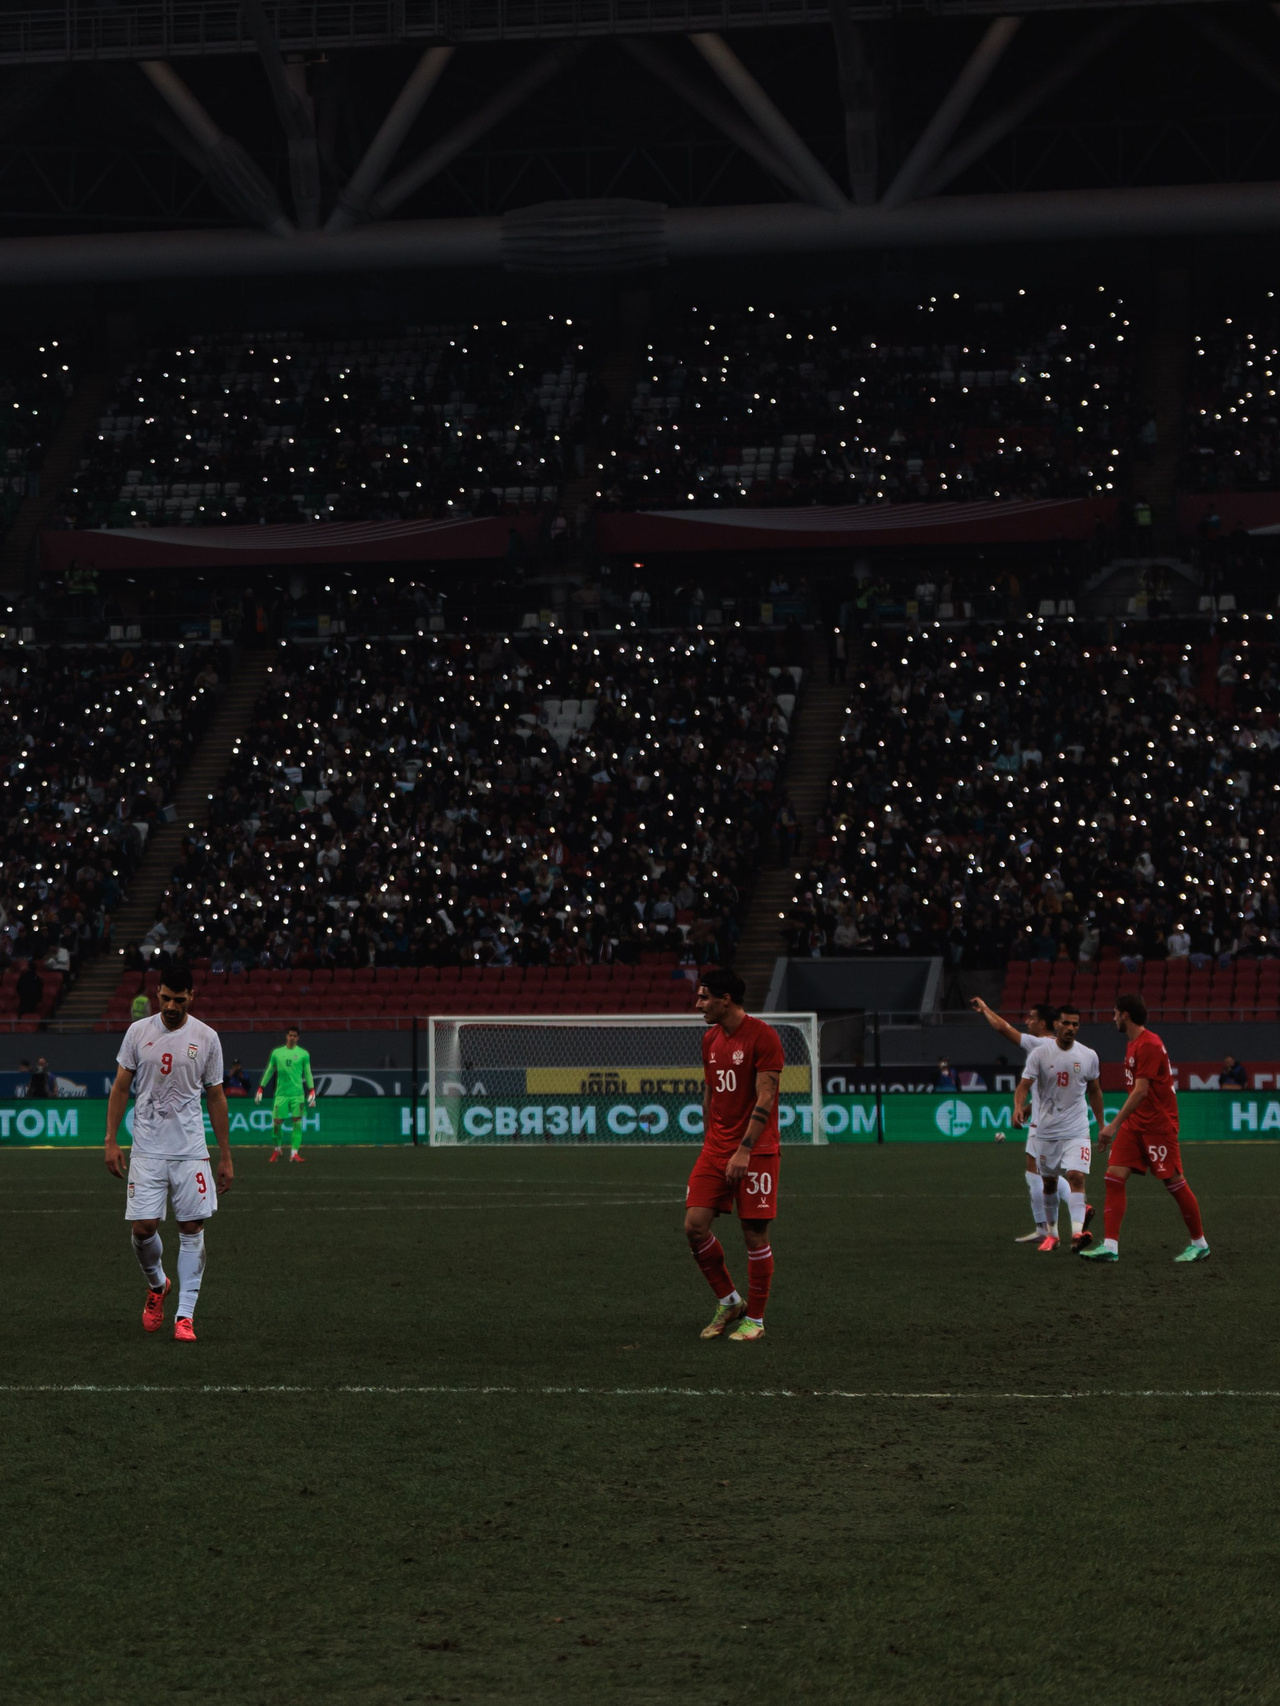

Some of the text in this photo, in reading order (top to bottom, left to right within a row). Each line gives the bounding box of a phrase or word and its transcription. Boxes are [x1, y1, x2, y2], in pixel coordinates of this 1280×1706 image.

[160, 1053, 173, 1075] 9
[715, 1069, 737, 1093] 30
[1057, 1072, 1069, 1087] 19
[401, 1103, 885, 1136] НА СВЯЗИ СО СРТОМ
[1231, 1101, 1280, 1131] НА
[1080, 1147, 1090, 1161] 19
[1148, 1145, 1168, 1162] 59
[196, 1172, 207, 1193] 9
[746, 1172, 772, 1195] 30
